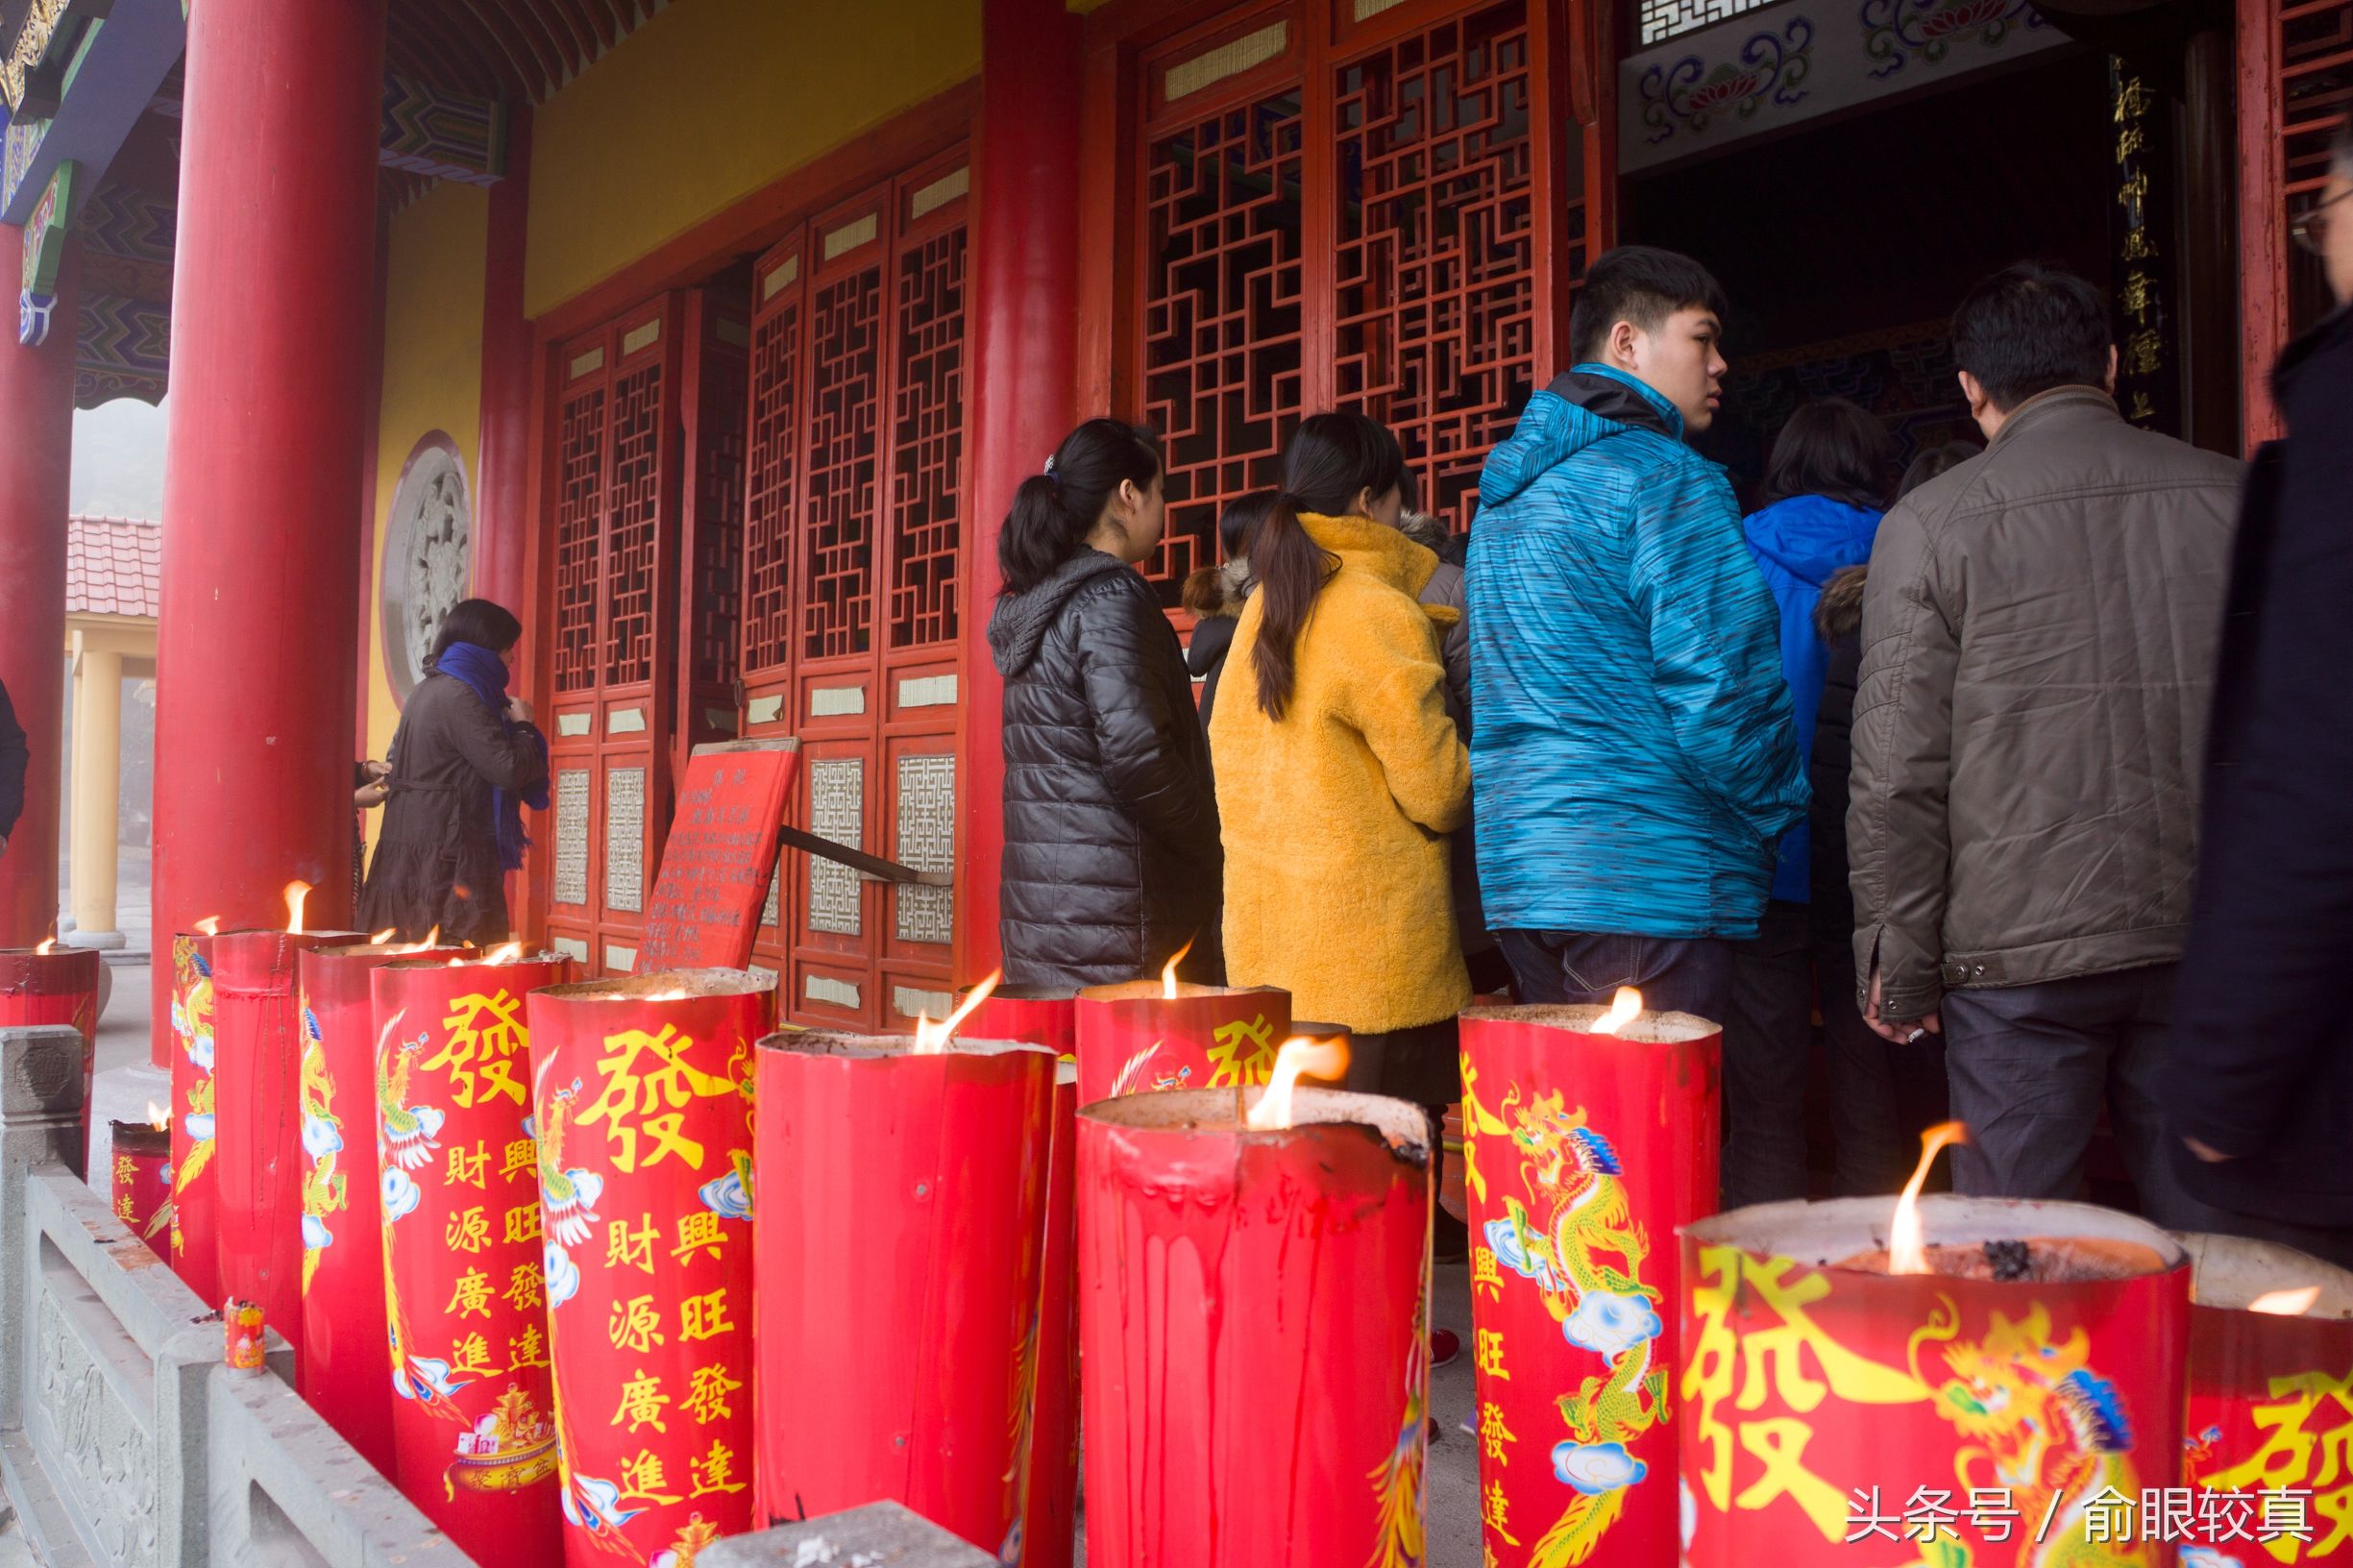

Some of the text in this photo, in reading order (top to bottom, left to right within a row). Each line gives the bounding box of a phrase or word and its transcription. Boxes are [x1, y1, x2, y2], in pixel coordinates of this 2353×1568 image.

[420, 988, 529, 1108] 發
[575, 1023, 739, 1173] 發
[443, 1139, 503, 1378] 財源廣進
[499, 1139, 551, 1372] 興旺發達
[604, 1213, 684, 1506] 財源廣進
[670, 1211, 748, 1499] 興旺發達
[1473, 1245, 1521, 1546] 興旺發達
[1681, 1245, 1934, 1543] 發
